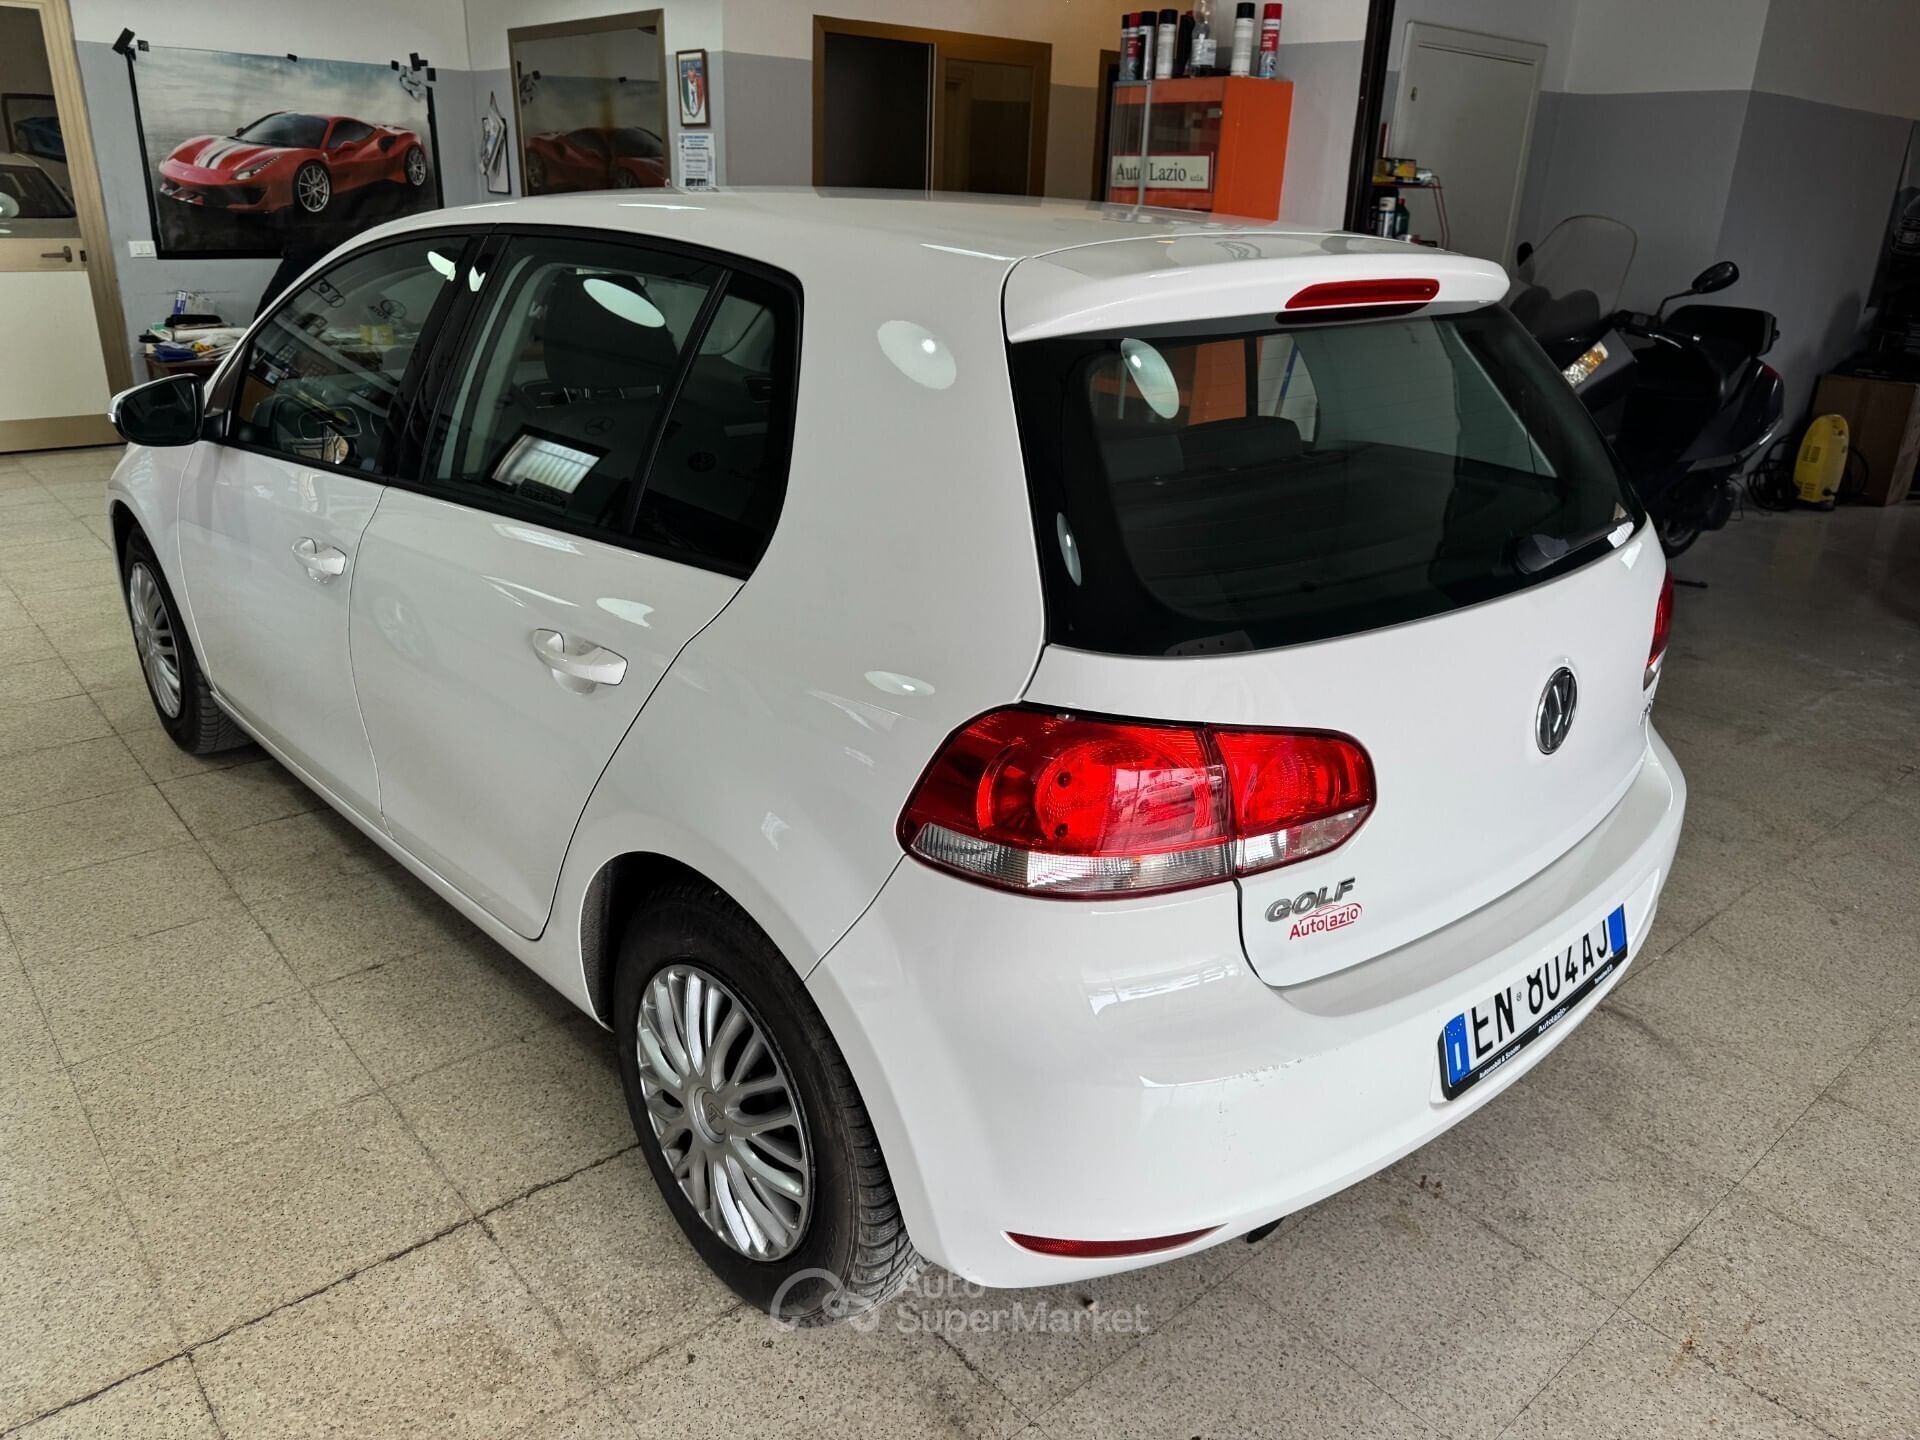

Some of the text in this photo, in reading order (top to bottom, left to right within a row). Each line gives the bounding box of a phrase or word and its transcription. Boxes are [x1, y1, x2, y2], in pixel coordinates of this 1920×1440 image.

[1149, 161, 1187, 181] Lazio
[1264, 876, 1356, 922] GOLF
[1471, 986, 1515, 1060] EN
